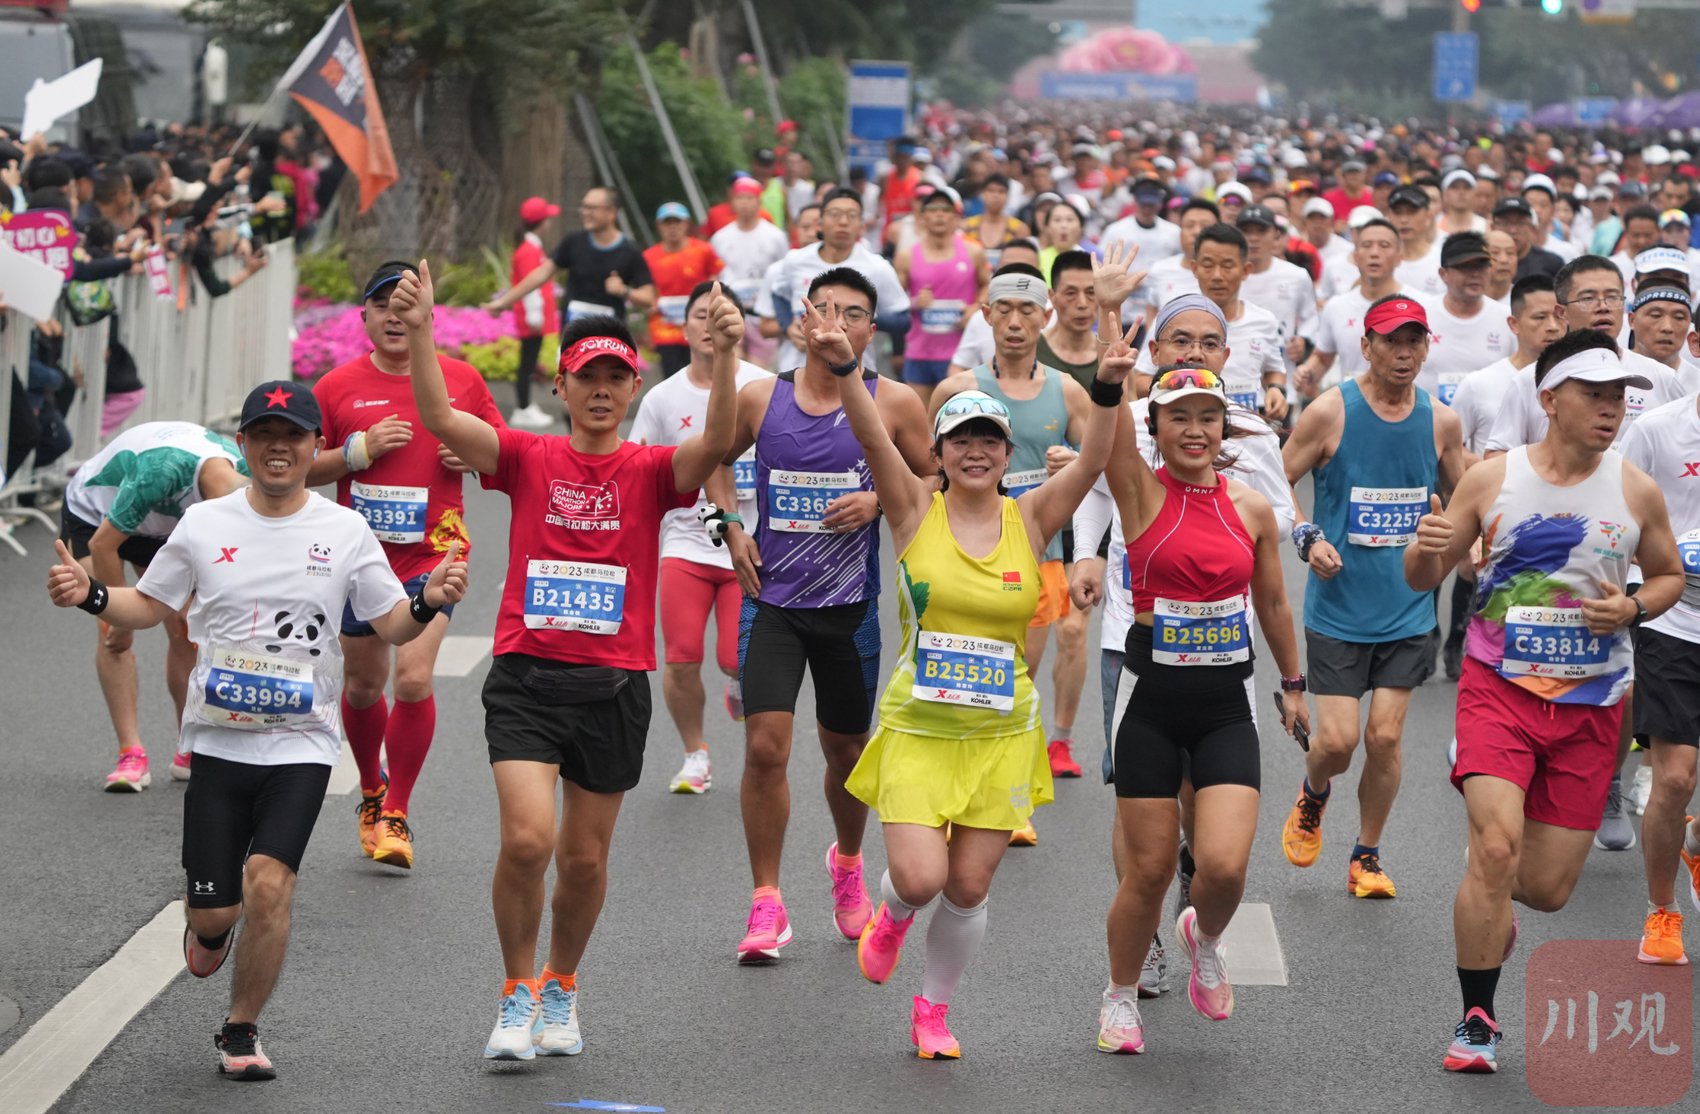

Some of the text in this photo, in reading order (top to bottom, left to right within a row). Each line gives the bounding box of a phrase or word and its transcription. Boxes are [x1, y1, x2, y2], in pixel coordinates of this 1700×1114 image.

[580, 338, 628, 355] JOYRUN
[792, 475, 818, 485] 2023
[364, 488, 389, 498] 2023
[553, 492, 586, 505] MARATHON
[554, 485, 586, 500] CHINA
[1376, 492, 1399, 501] 2023
[552, 496, 584, 511] MAJORS
[775, 495, 835, 513] C336
[1358, 511, 1421, 528] C32257
[552, 564, 615, 577] 2023 成都马拉松
[532, 588, 615, 612] B21435
[1183, 605, 1213, 616] 2023
[1536, 612, 1566, 623] 2023
[578, 623, 601, 631] KOHLER
[1162, 624, 1241, 645] B25696
[946, 638, 976, 651] 2023
[1515, 635, 1600, 656] C33814
[238, 658, 268, 672] 2023
[925, 660, 1006, 687] B25520
[215, 681, 302, 708] C33994
[970, 697, 992, 705] KOHLER
